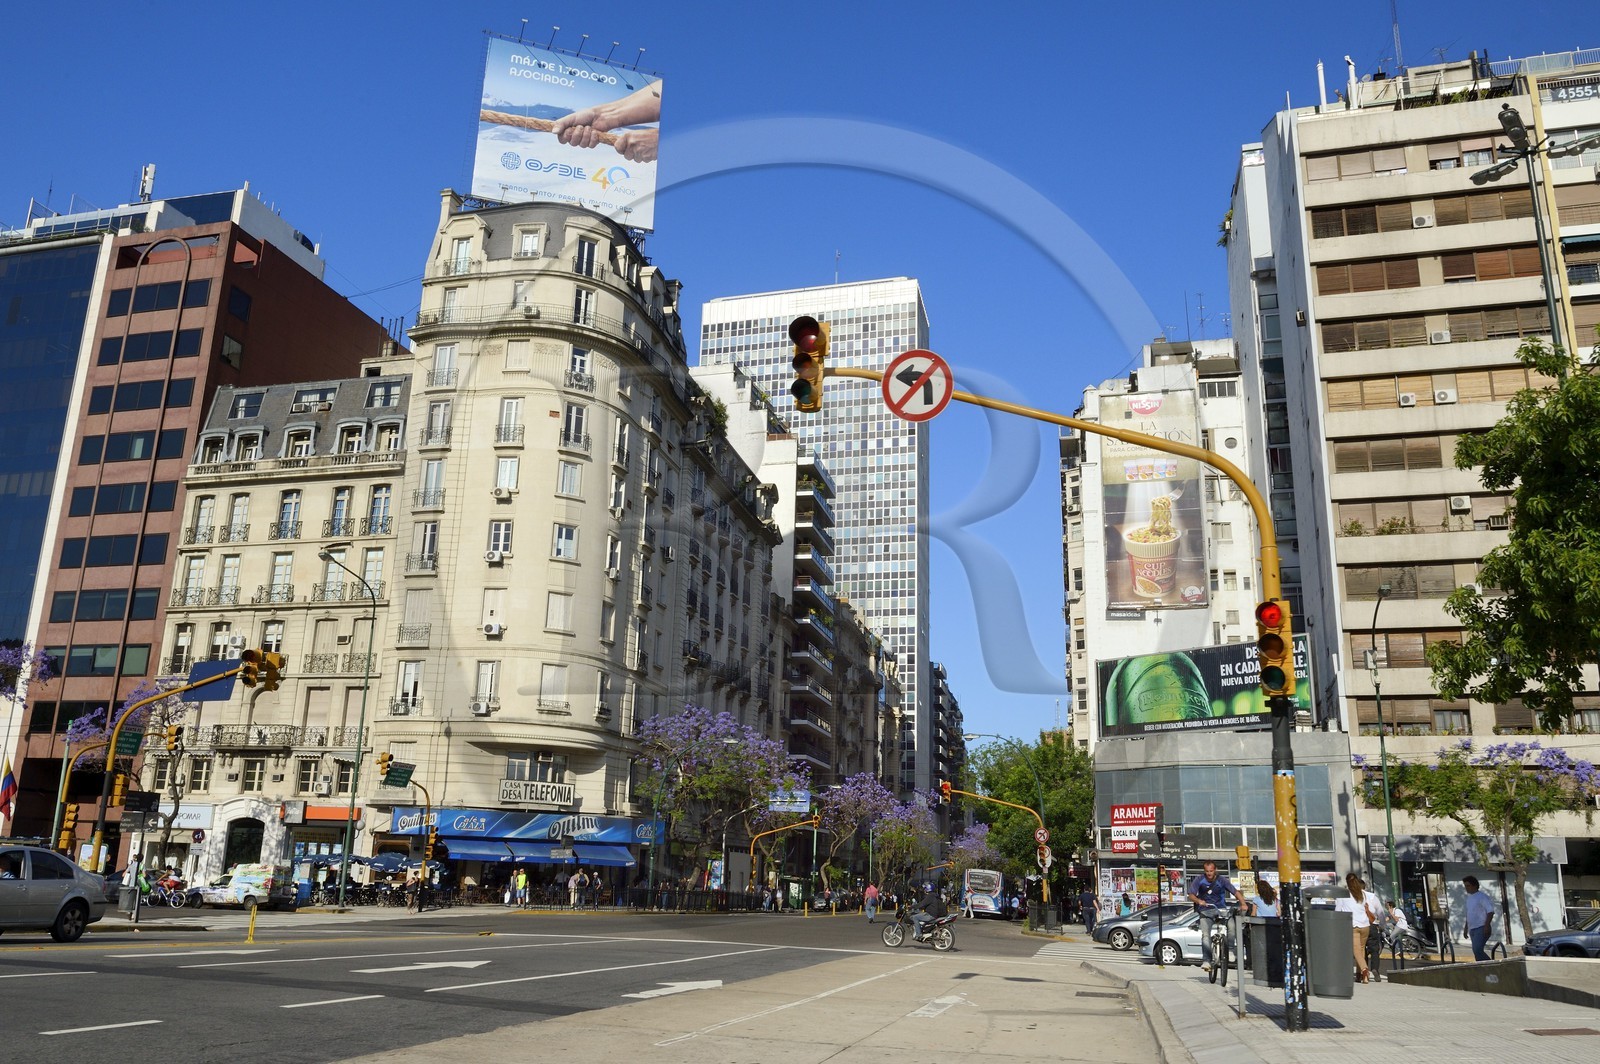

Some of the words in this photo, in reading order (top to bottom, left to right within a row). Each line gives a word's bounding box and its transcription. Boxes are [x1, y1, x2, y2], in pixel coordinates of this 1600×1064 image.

[510, 54, 537, 67] MÁS
[541, 61, 556, 72] DE
[509, 67, 575, 88] ASOCIADOS.
[525, 158, 587, 180] OSDE
[591, 165, 630, 189] 40
[498, 183, 528, 194] TANDO
[1131, 400, 1160, 410] NISSIN
[1140, 421, 1157, 431] LA
[1144, 562, 1166, 570] CUP
[1137, 567, 1172, 577] NOODLES
[1220, 664, 1233, 677] EN
[1235, 661, 1261, 675] CADA
[1221, 677, 1244, 687] NUEVA
[504, 781, 521, 789] CASA
[501, 789, 522, 800] DESA
[523, 783, 572, 804] TELEFONIA
[168, 812, 201, 820] CPOMAR
[1113, 829, 1129, 837] LOCAL
[1130, 829, 1137, 837] EN
